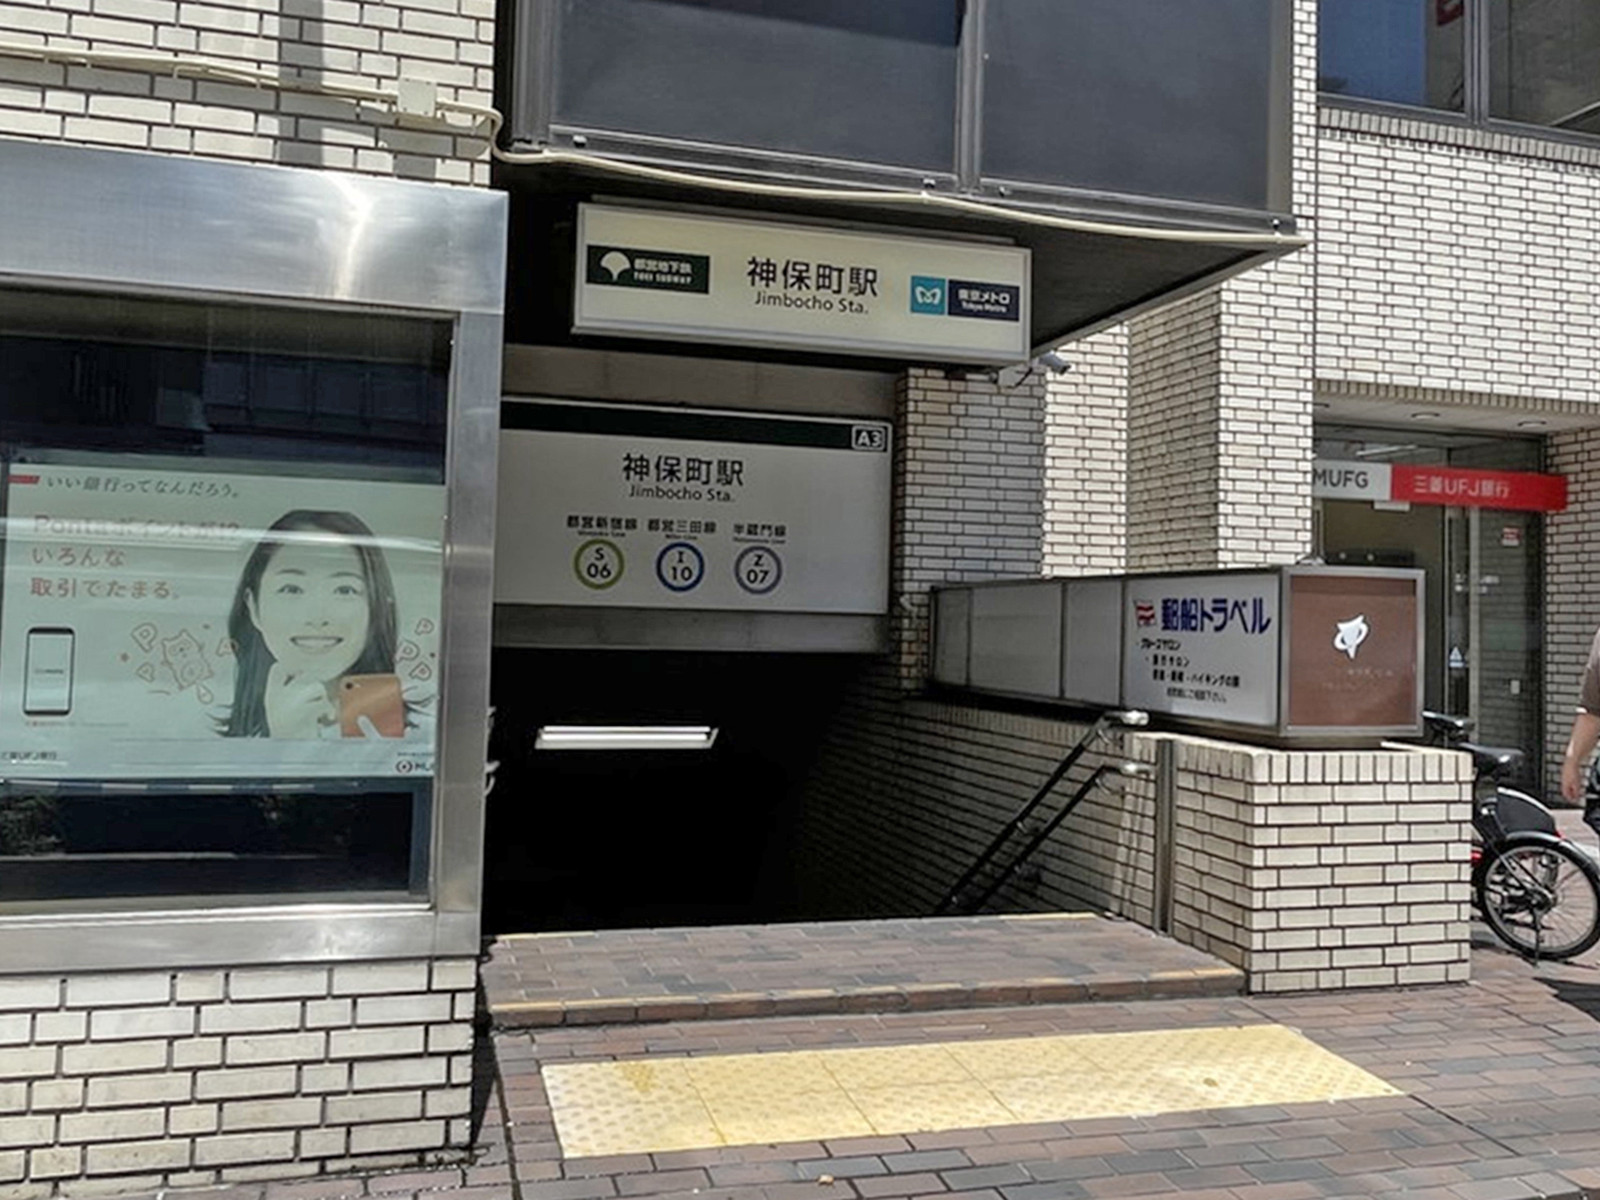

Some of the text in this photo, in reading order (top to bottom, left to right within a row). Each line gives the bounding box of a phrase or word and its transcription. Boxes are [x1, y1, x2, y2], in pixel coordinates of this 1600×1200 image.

[747, 256, 878, 298] 神保町駅
[755, 290, 869, 314] Jimbocho Sta.
[857, 430, 882, 447] A3
[622, 453, 743, 487] 神保町駅
[1312, 469, 1369, 488] MUFG
[47, 475, 240, 499] いい銀行ってなんだろう。
[629, 485, 736, 502] Jimbocho Sta.
[1413, 474, 1510, 498] 三菱UFJ銀行
[32, 547, 124, 567] いろんな
[594, 547, 605, 561] S
[753, 553, 764, 567] Z
[586, 562, 612, 579] 06
[671, 566, 693, 582] 10
[746, 568, 770, 585] 07
[30, 576, 180, 600] 取引でたまる。
[1161, 597, 1271, 635] 郵船トラベル
